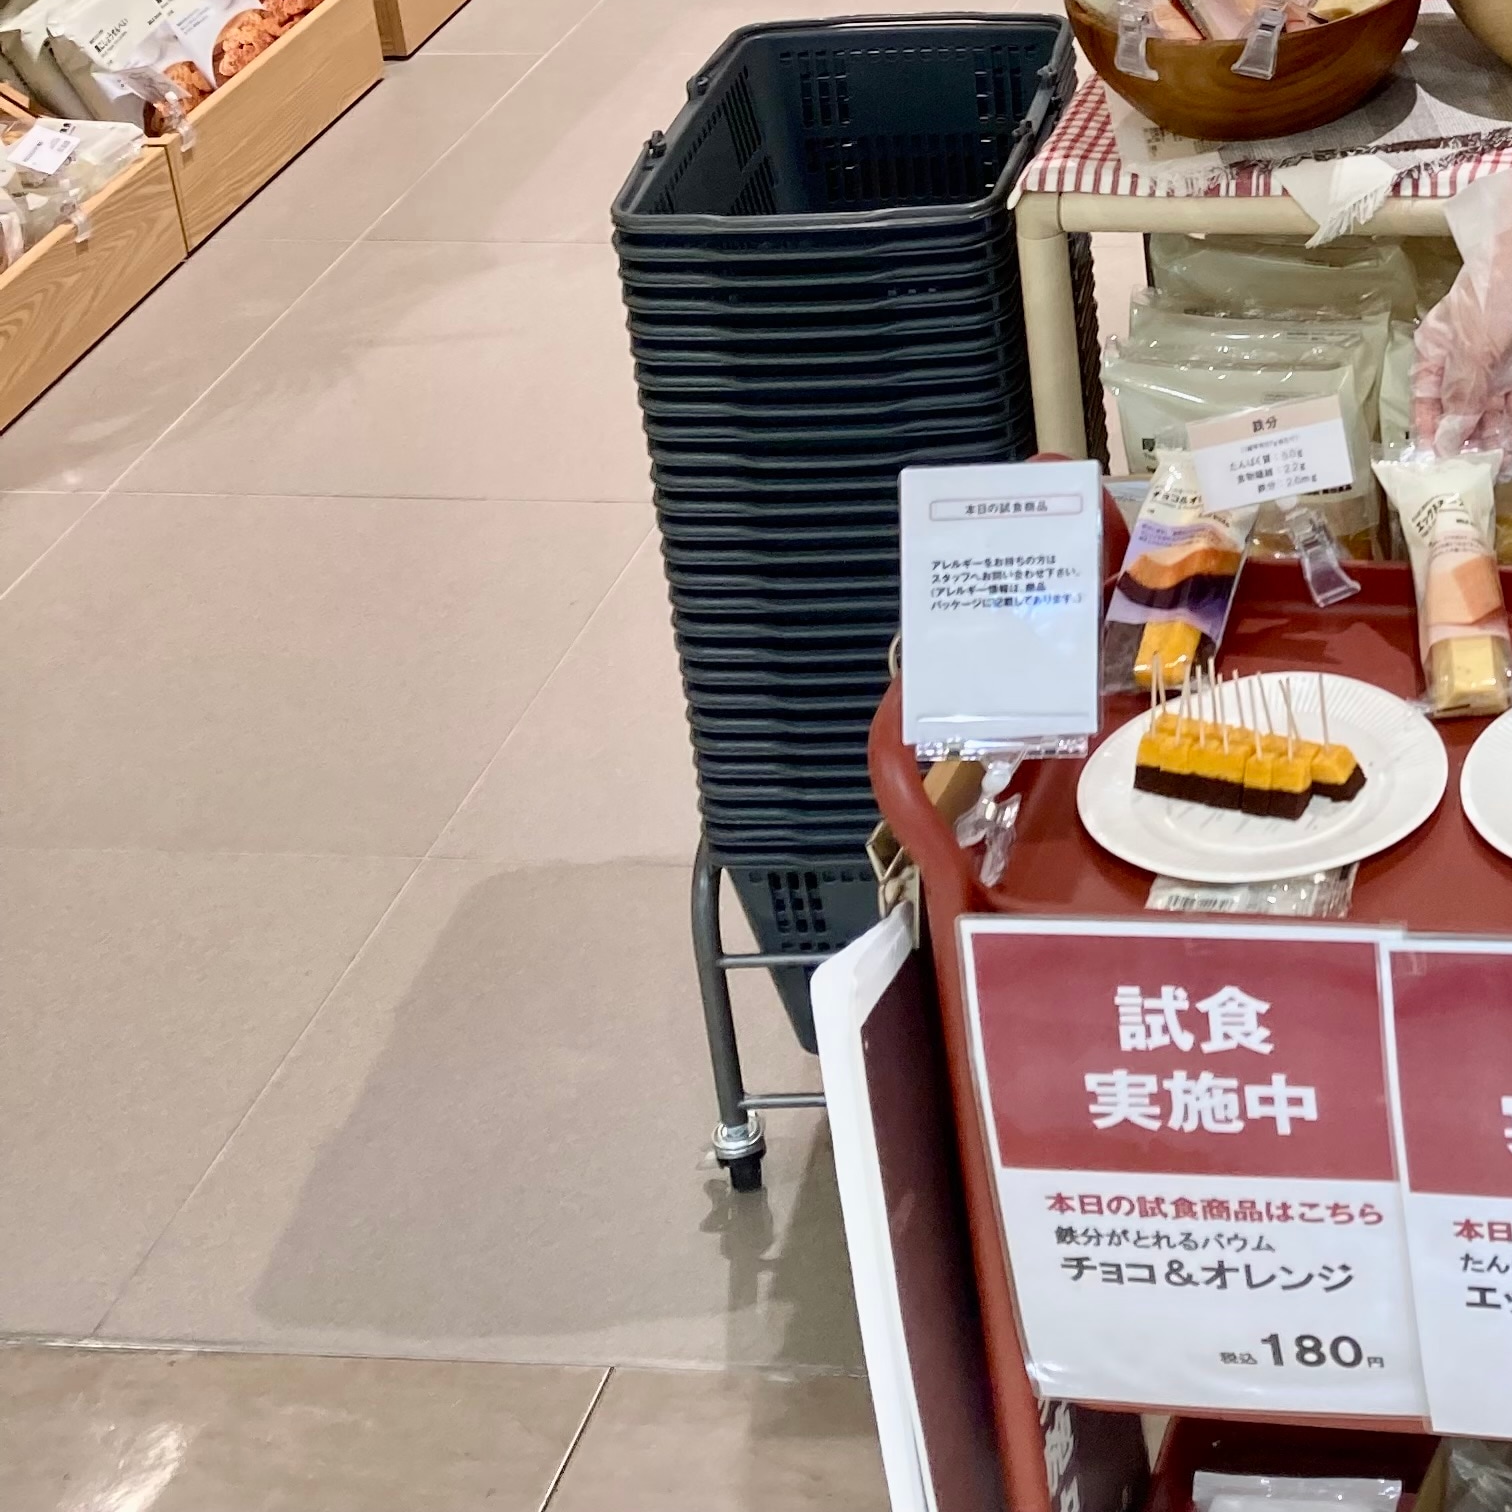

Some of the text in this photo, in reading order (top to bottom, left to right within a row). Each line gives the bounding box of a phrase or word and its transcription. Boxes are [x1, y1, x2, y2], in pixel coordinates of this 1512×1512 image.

[1252, 415, 1278, 433] 鉄分
[965, 500, 1048, 515] 本日の試食商品
[931, 554, 1057, 571] アレルギーをお持ちの方は
[1113, 984, 1275, 1056] 試食
[1084, 1068, 1319, 1137] 実施中
[1045, 1191, 1385, 1226] 本日の試食商品はこちら
[1055, 1225, 1276, 1254] 鉄分がとれるバウム
